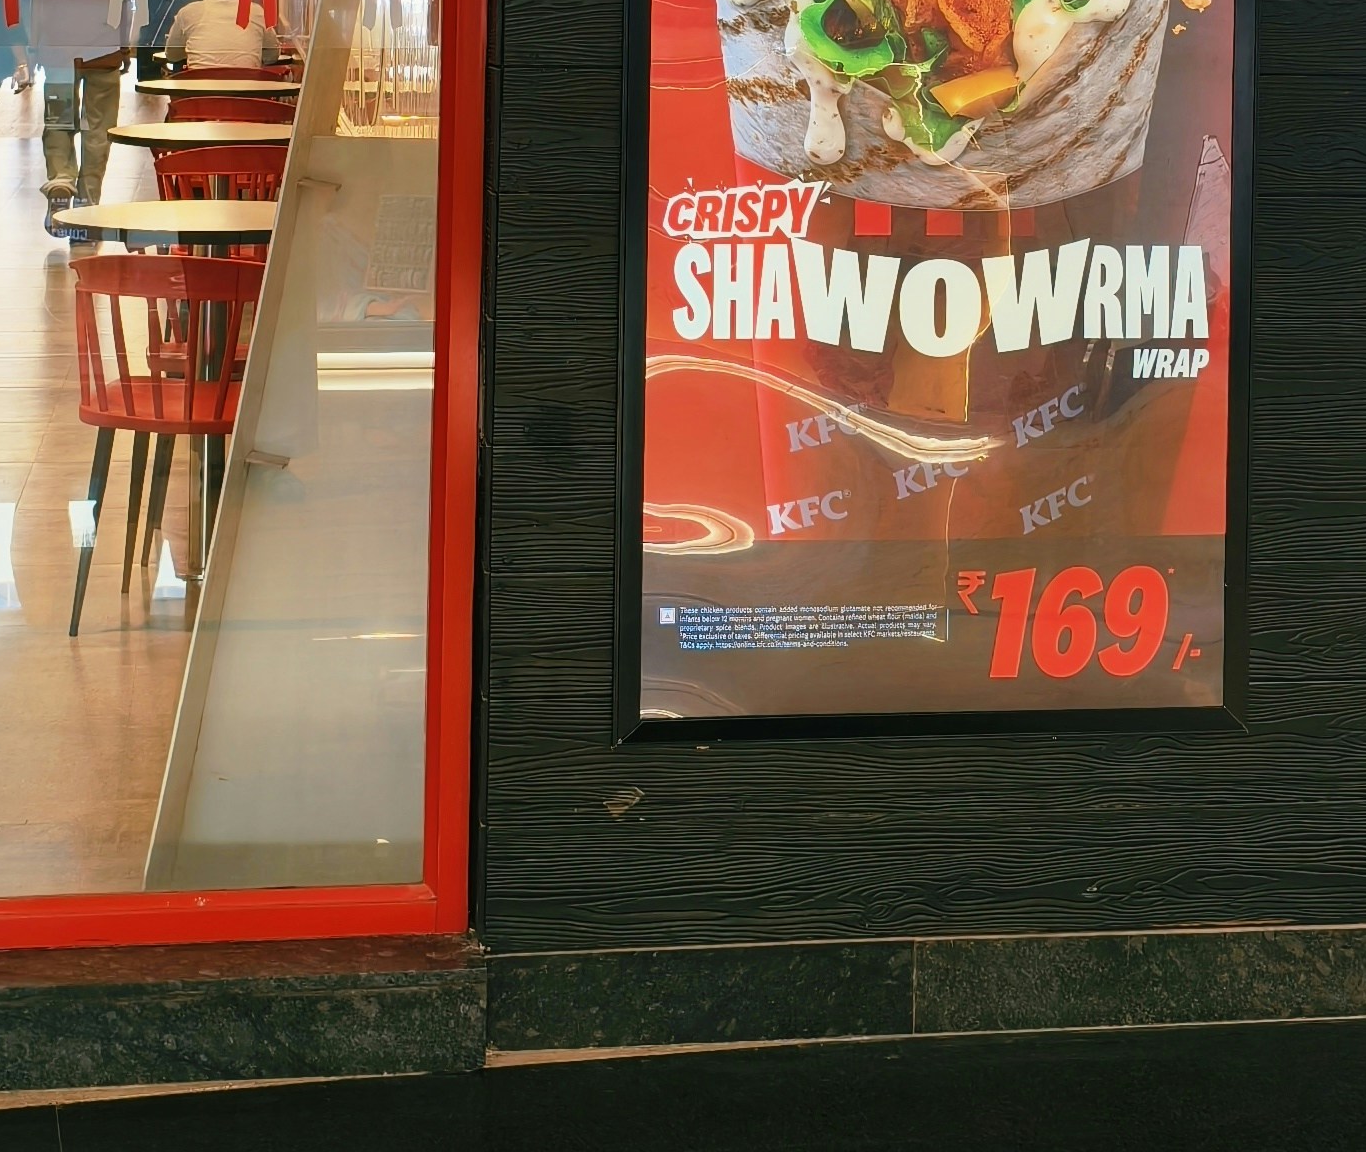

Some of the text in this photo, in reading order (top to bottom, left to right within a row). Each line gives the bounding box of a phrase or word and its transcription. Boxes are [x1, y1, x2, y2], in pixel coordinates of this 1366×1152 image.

[666, 185, 817, 235] CRISPY
[672, 237, 1209, 357] SHAWOWRMA
[1132, 348, 1210, 379] WRAP
[1011, 385, 1085, 448] KFC
[766, 490, 848, 535] KFC
[1019, 476, 1092, 535] KFC
[680, 624, 713, 632] proprietary
[716, 623, 732, 632] spice
[759, 623, 782, 631] Product
[786, 623, 806, 632] images
[880, 622, 905, 630] products
[701, 606, 723, 614] chicken
[726, 606, 752, 615] products
[755, 606, 776, 614] contain
[841, 605, 870, 614] glutamate
[766, 615, 792, 623] pregnant
[699, 632, 726, 640] exclusive
[788, 632, 808, 640] pricing
[810, 631, 836, 639] available
